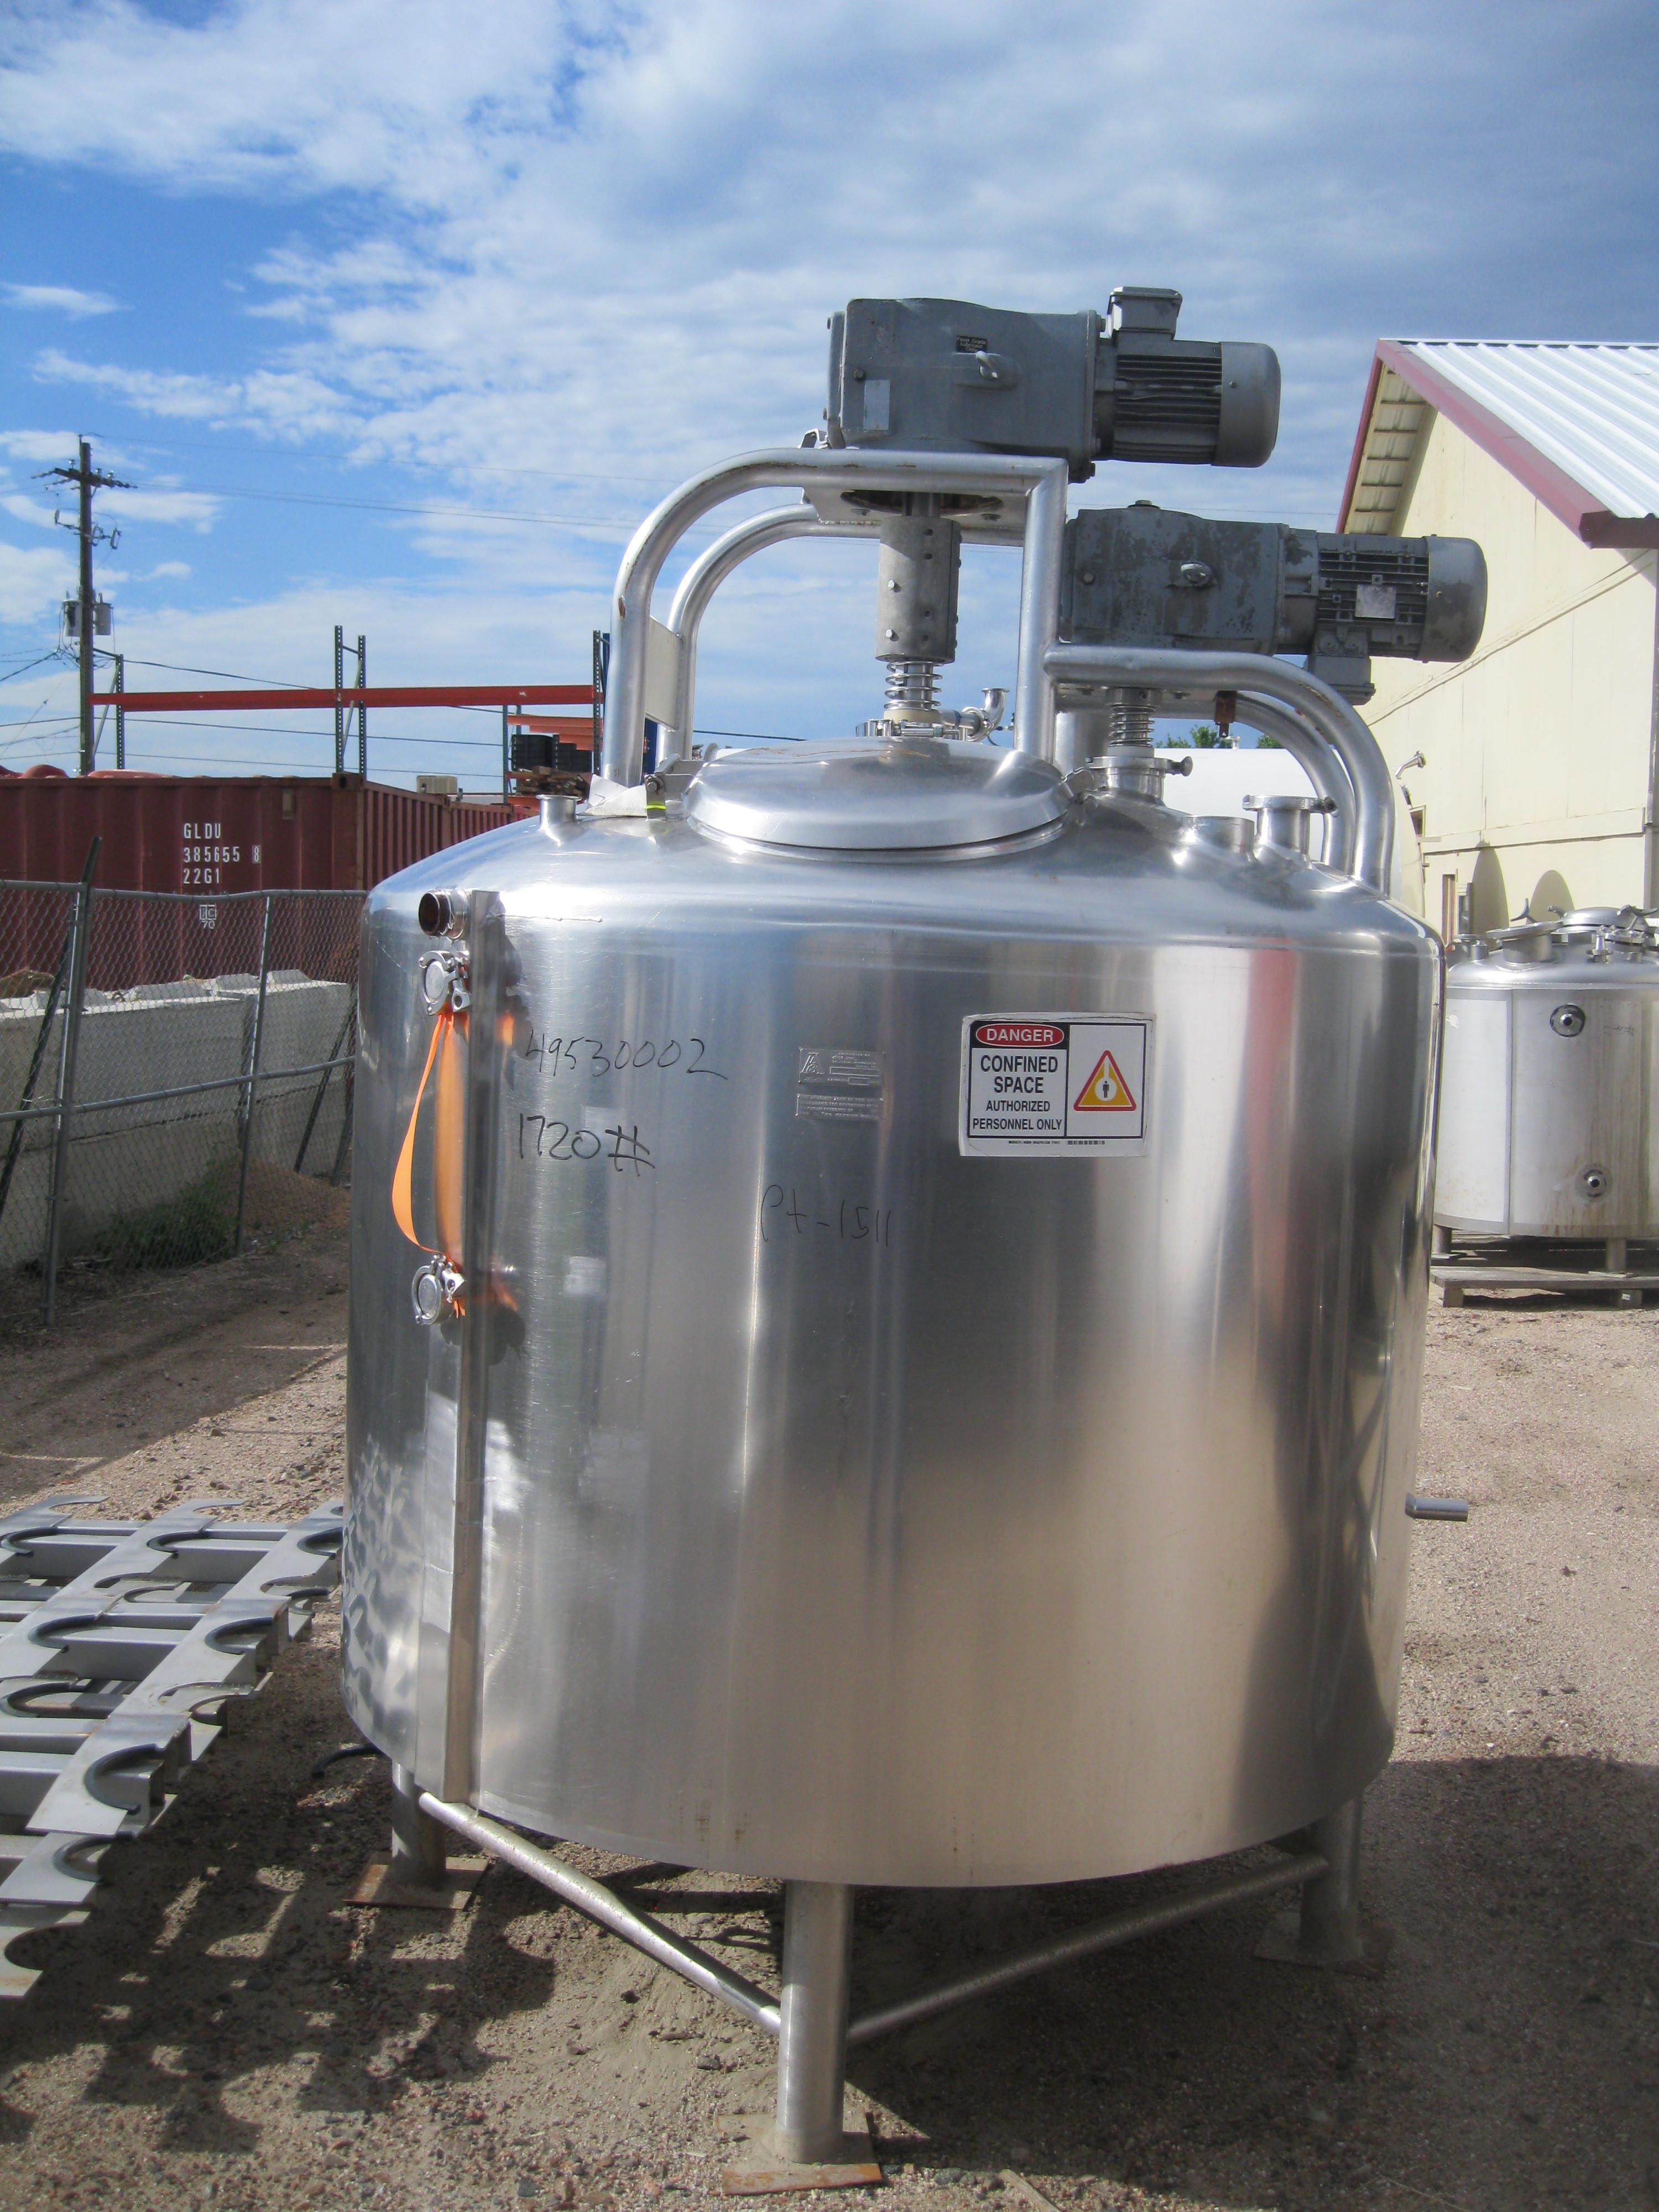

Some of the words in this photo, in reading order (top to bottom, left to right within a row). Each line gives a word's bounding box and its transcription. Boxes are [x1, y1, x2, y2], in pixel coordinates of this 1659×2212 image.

[184, 823, 221, 839] GLDU
[184, 847, 240, 863] 385655
[253, 846, 260, 863] 8
[183, 868, 220, 884] 22G1
[987, 1029, 1053, 1042] DANGER
[525, 1029, 728, 1080] 49530002
[980, 1055, 1058, 1073] CONFINED
[994, 1076, 1044, 1093] SPACE
[986, 1100, 1050, 1112] AUTHORIZED
[973, 1118, 1034, 1130] PERSONNEL
[1037, 1119, 1062, 1130] ONLY
